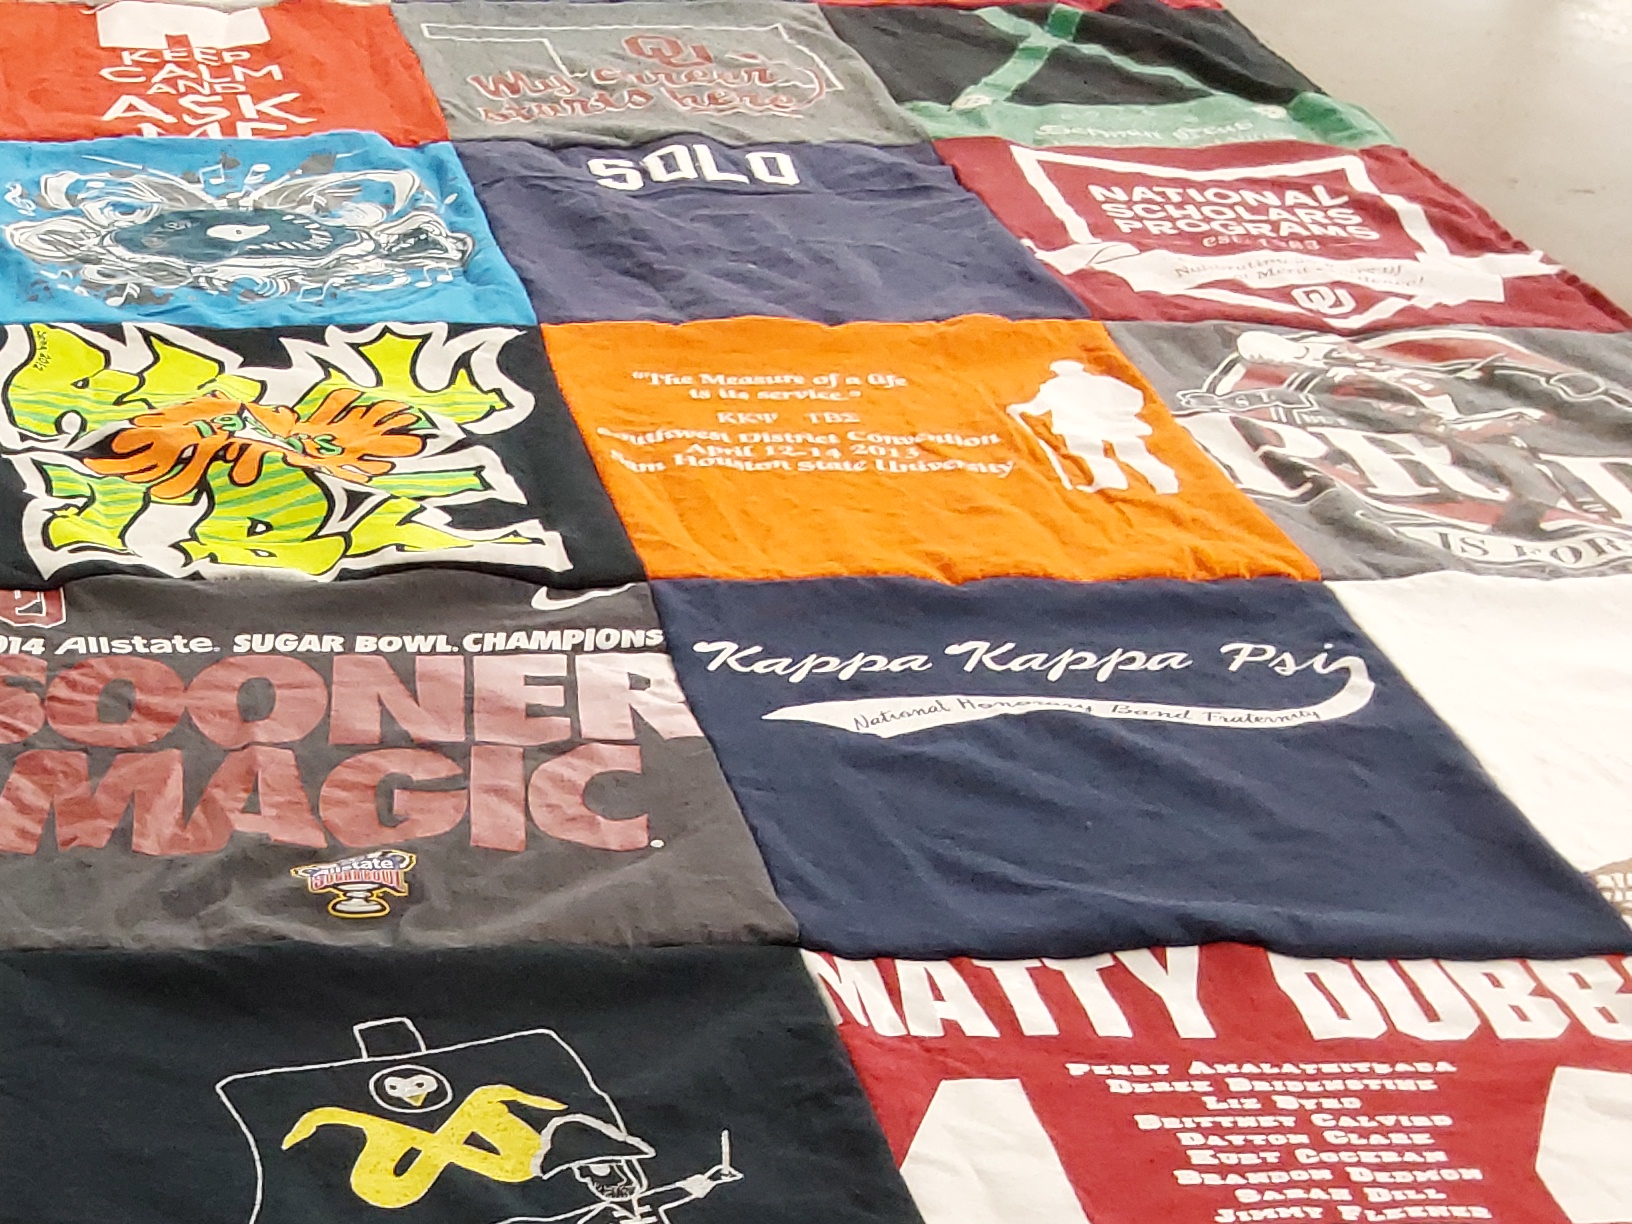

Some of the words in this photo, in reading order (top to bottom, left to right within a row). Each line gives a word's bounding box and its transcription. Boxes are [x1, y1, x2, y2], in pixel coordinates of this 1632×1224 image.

[121, 48, 251, 66] KEEP
[99, 63, 284, 83] CALM
[146, 79, 247, 95] AND
[100, 92, 318, 126] ASK
[586, 143, 801, 191] SOLO
[1087, 183, 1349, 208] NATIONAL
[1100, 201, 1363, 226] SCHOLARS
[1116, 218, 1380, 242] PROGRAMS
[699, 372, 805, 387] Measure
[812, 372, 838, 389] of
[845, 376, 863, 387] a
[689, 389, 712, 400] is
[719, 389, 750, 400] its
[738, 430, 840, 445] District
[686, 442, 757, 458] April
[765, 444, 843, 458] 12-14
[232, 633, 345, 654] SUGAR
[462, 627, 665, 652] CHAMPIONS
[693, 639, 933, 684] Kappa
[944, 639, 1193, 683] Kappa
[1219, 641, 1338, 677] Psi
[852, 699, 951, 732] National
[1111, 703, 1192, 720] Band
[1202, 709, 1321, 725] Fraternity
[799, 945, 1218, 1040] MATTY
[1266, 951, 1632, 1042] DUBB
[1065, 1061, 1170, 1077] PERRY
[1105, 1077, 1214, 1094] DEREK
[1201, 1095, 1262, 1111] LIZ
[1271, 1094, 1363, 1111] BYRD
[1133, 1113, 1297, 1131] BRITTNEY
[1176, 1131, 1311, 1147] DAYTON
[1322, 1130, 1436, 1146] CLARK
[1186, 1149, 1281, 1166] KURT
[1172, 1168, 1334, 1186] BRANDON
[1344, 1165, 1484, 1184] DEDMON
[1234, 1187, 1353, 1204] SARAH
[1363, 1186, 1448, 1203] DILL
[1214, 1205, 1324, 1224] JIMMY
